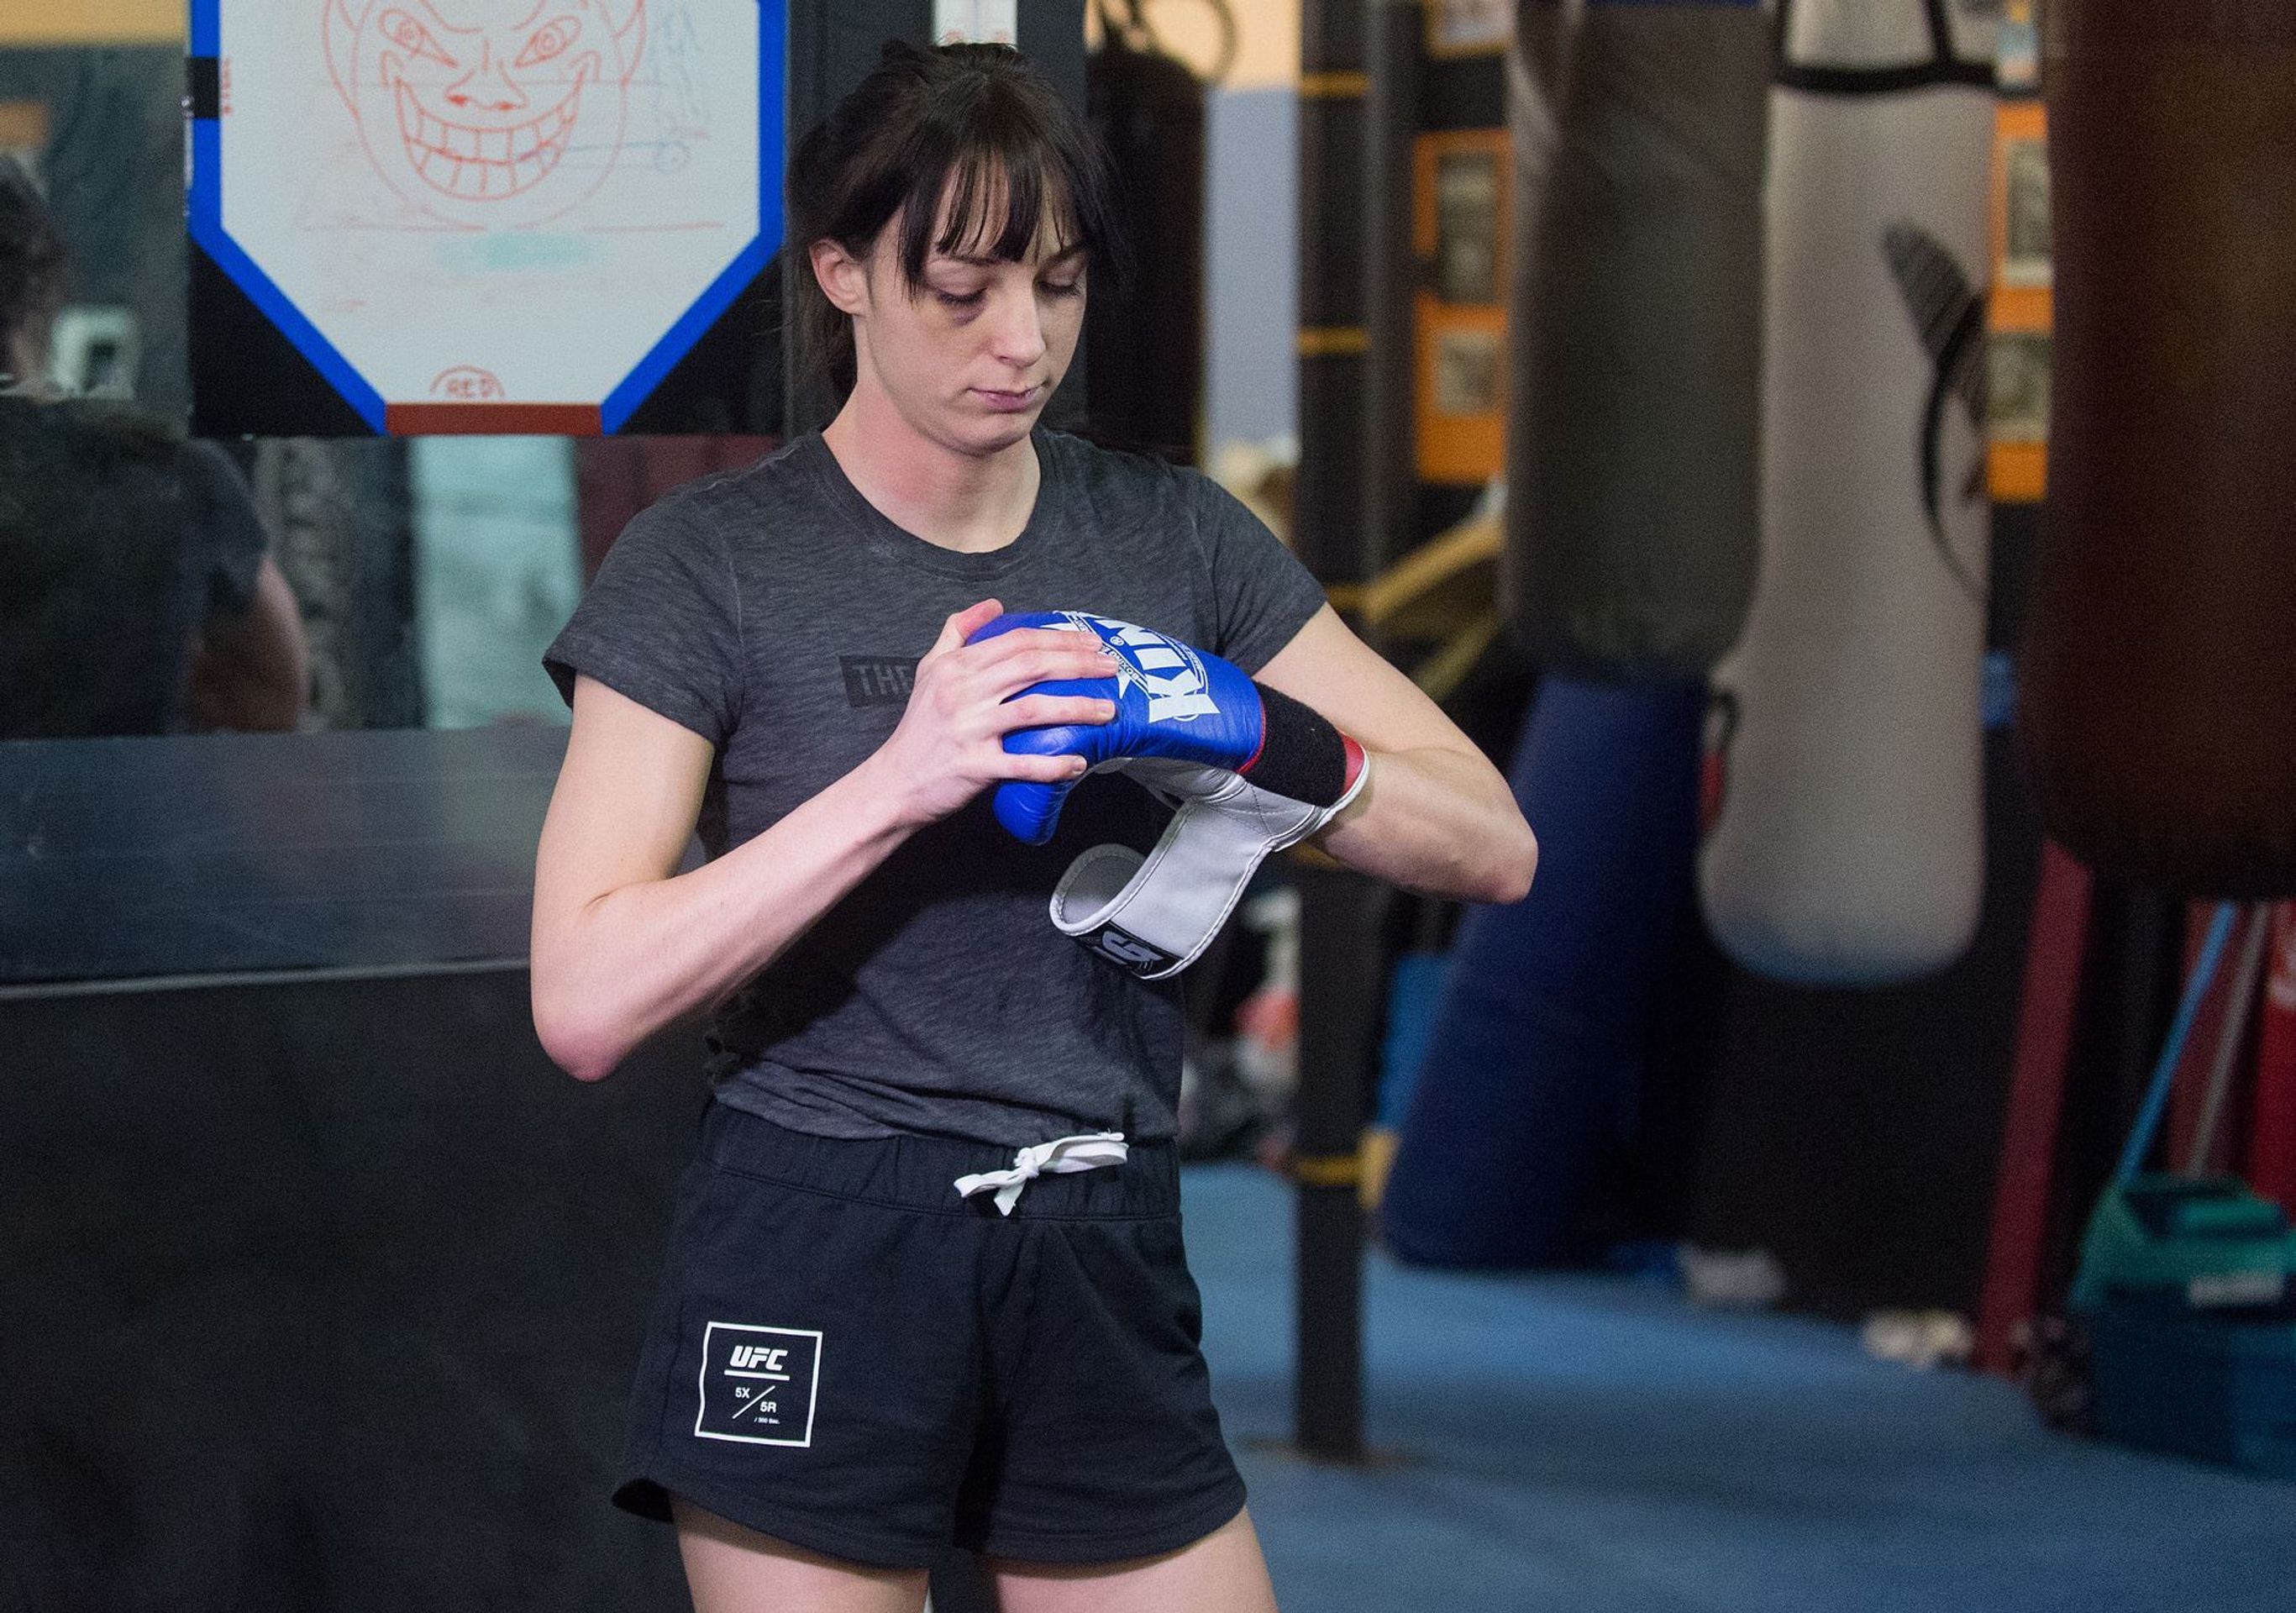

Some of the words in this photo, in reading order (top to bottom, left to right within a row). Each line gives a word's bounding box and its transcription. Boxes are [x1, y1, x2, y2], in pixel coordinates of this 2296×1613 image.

[446, 377, 495, 398] RED
[1094, 617, 1220, 723] KIN
[1109, 650, 1141, 681] BOXING
[729, 1345, 788, 1371] UFC
[735, 1387, 750, 1399] 5X
[759, 1401, 777, 1413] 5R
